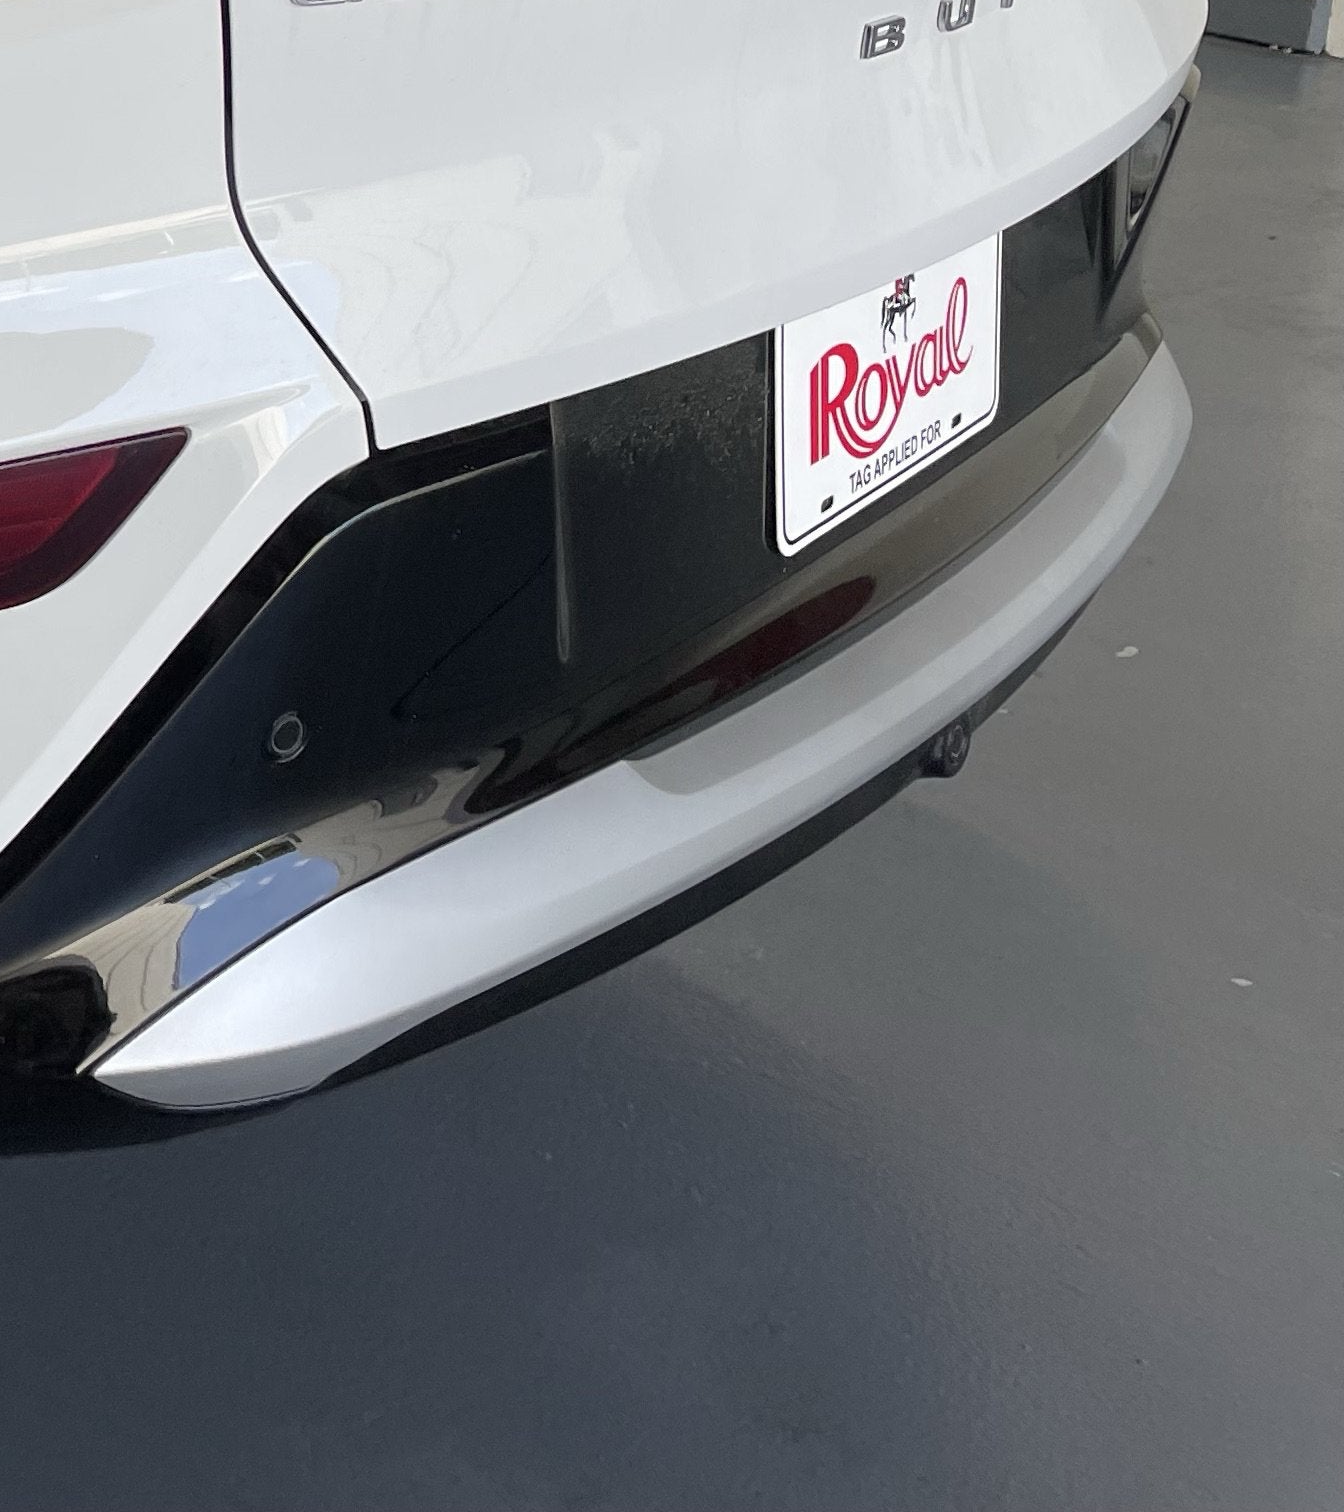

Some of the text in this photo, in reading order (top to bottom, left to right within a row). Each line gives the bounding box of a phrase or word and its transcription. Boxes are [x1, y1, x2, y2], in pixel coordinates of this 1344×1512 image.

[810, 276, 974, 466] Royal
[849, 419, 942, 494] TAG APPLIED FOR
